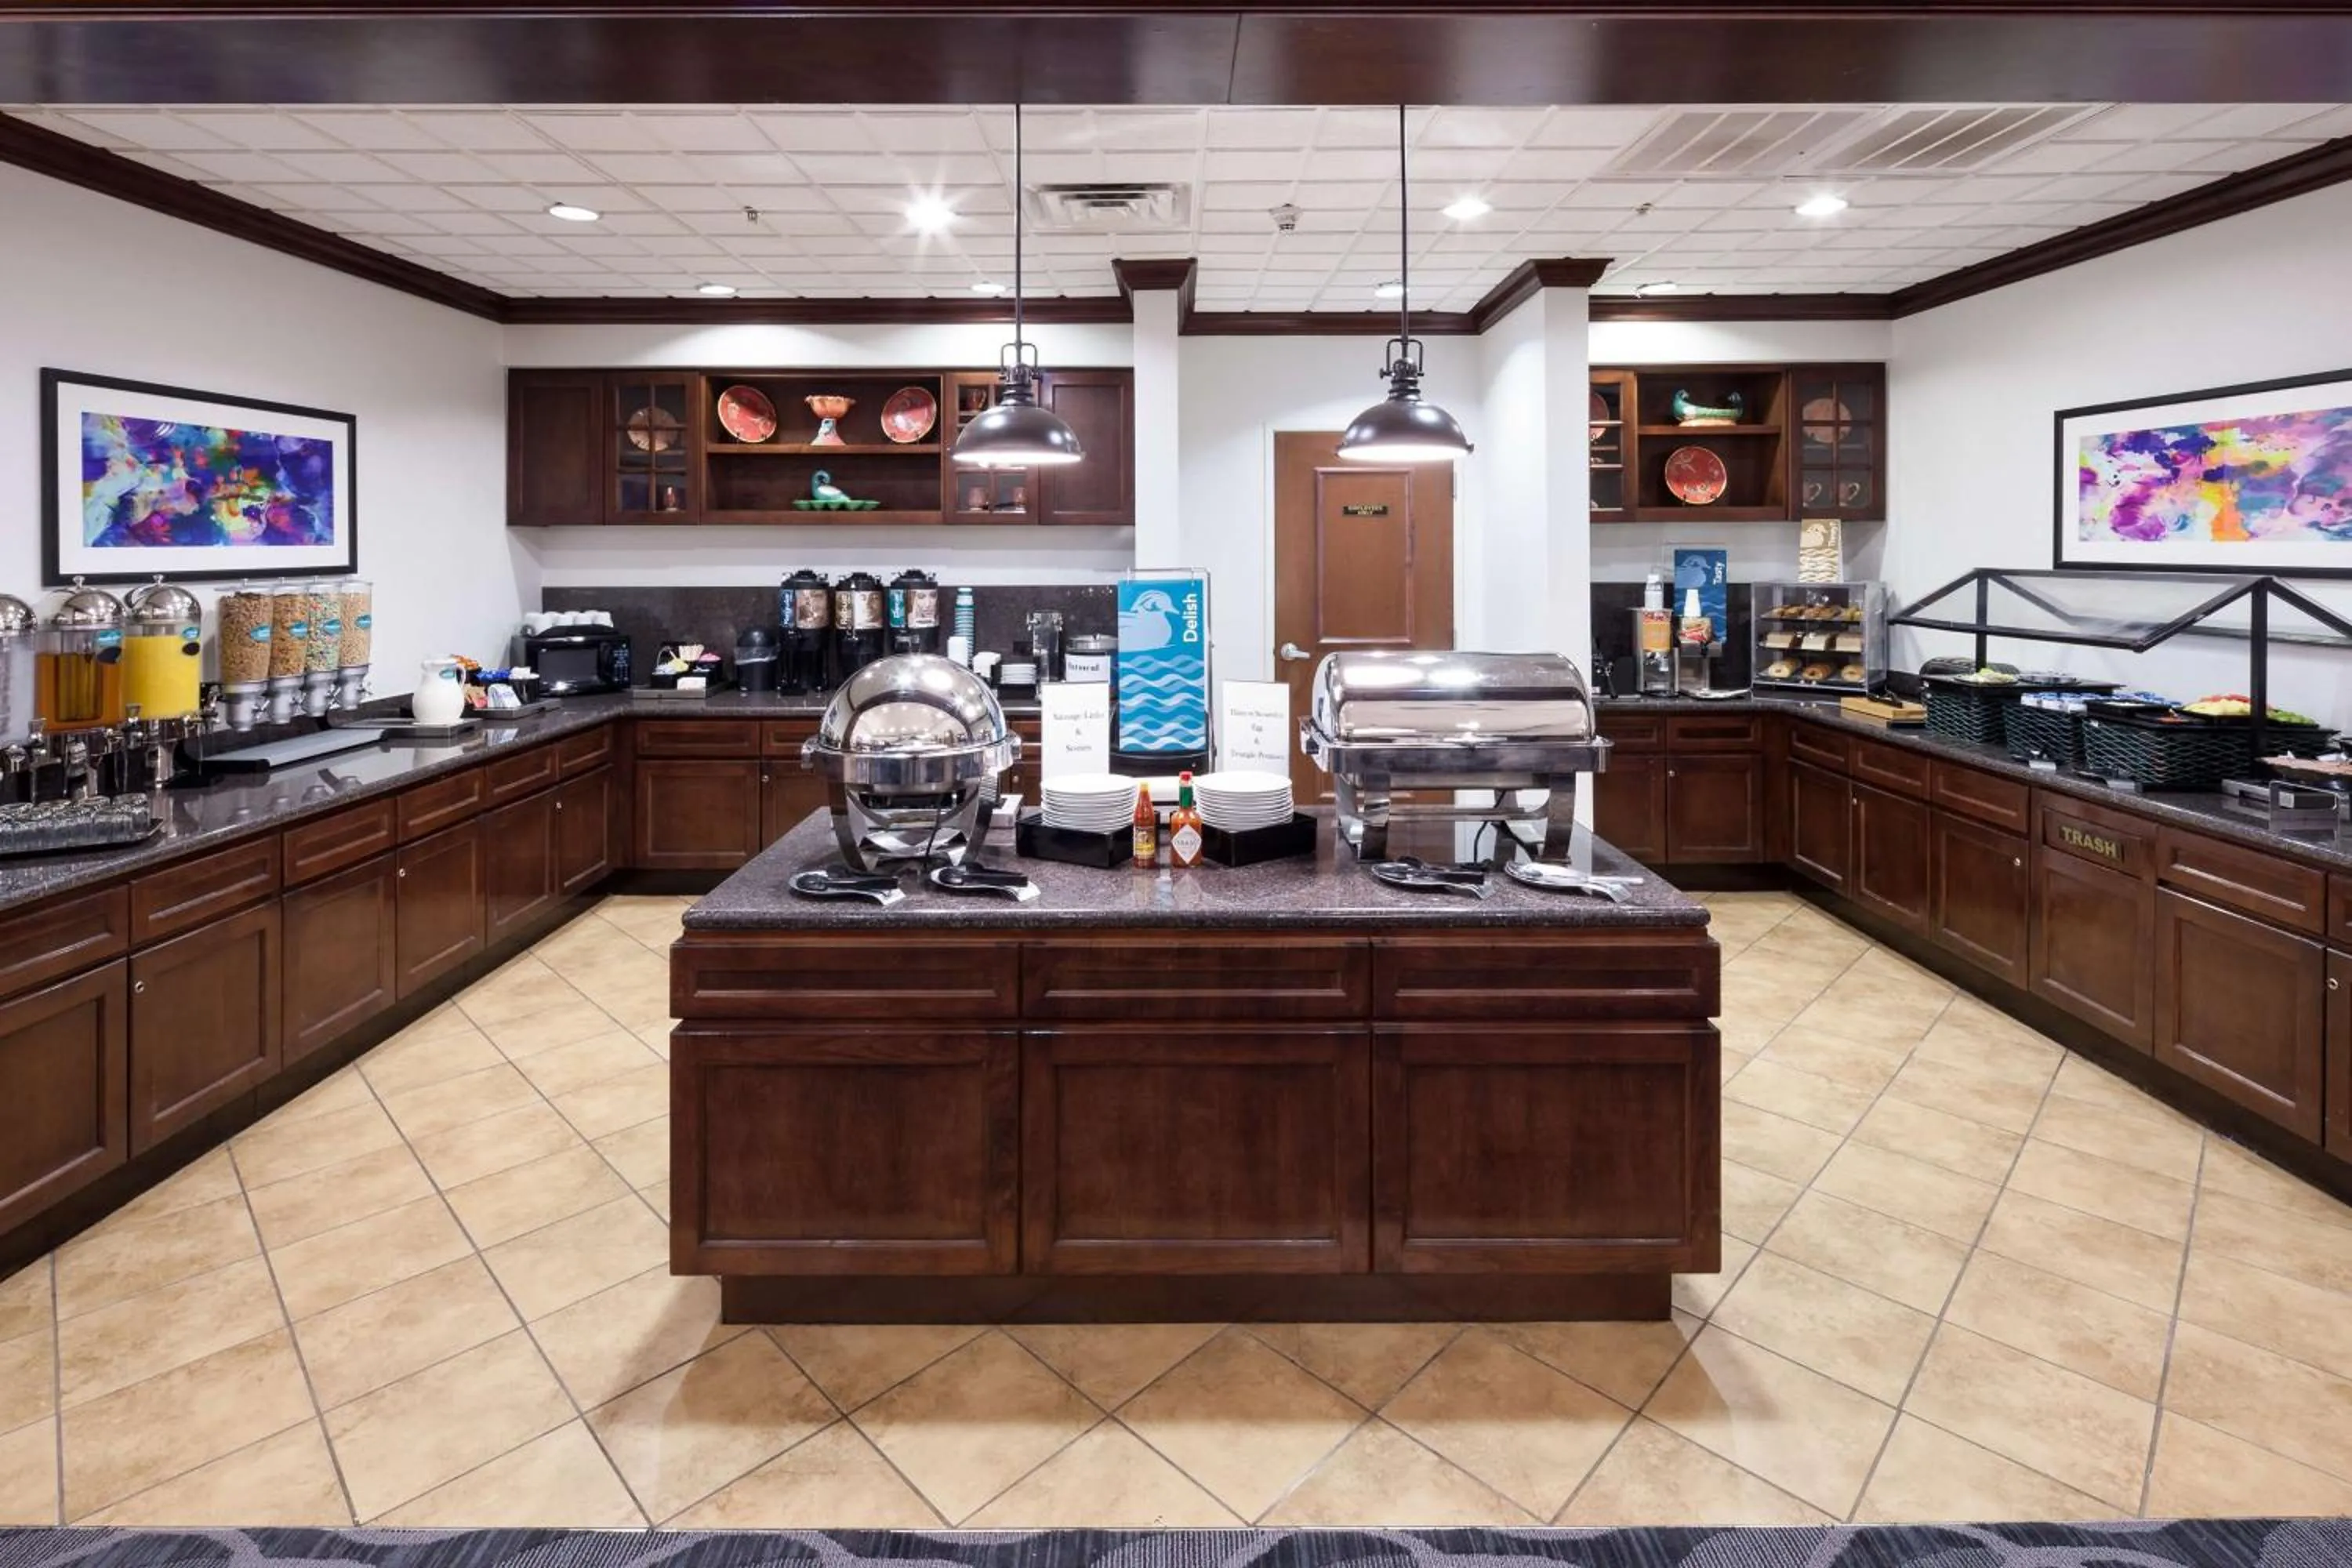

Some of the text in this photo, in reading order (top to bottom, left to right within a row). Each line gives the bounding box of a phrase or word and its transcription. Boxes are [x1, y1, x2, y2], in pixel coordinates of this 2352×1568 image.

[1713, 561, 1725, 585] Tasty
[1182, 593, 1198, 642] Delish
[2061, 826, 2116, 858] TRASH
